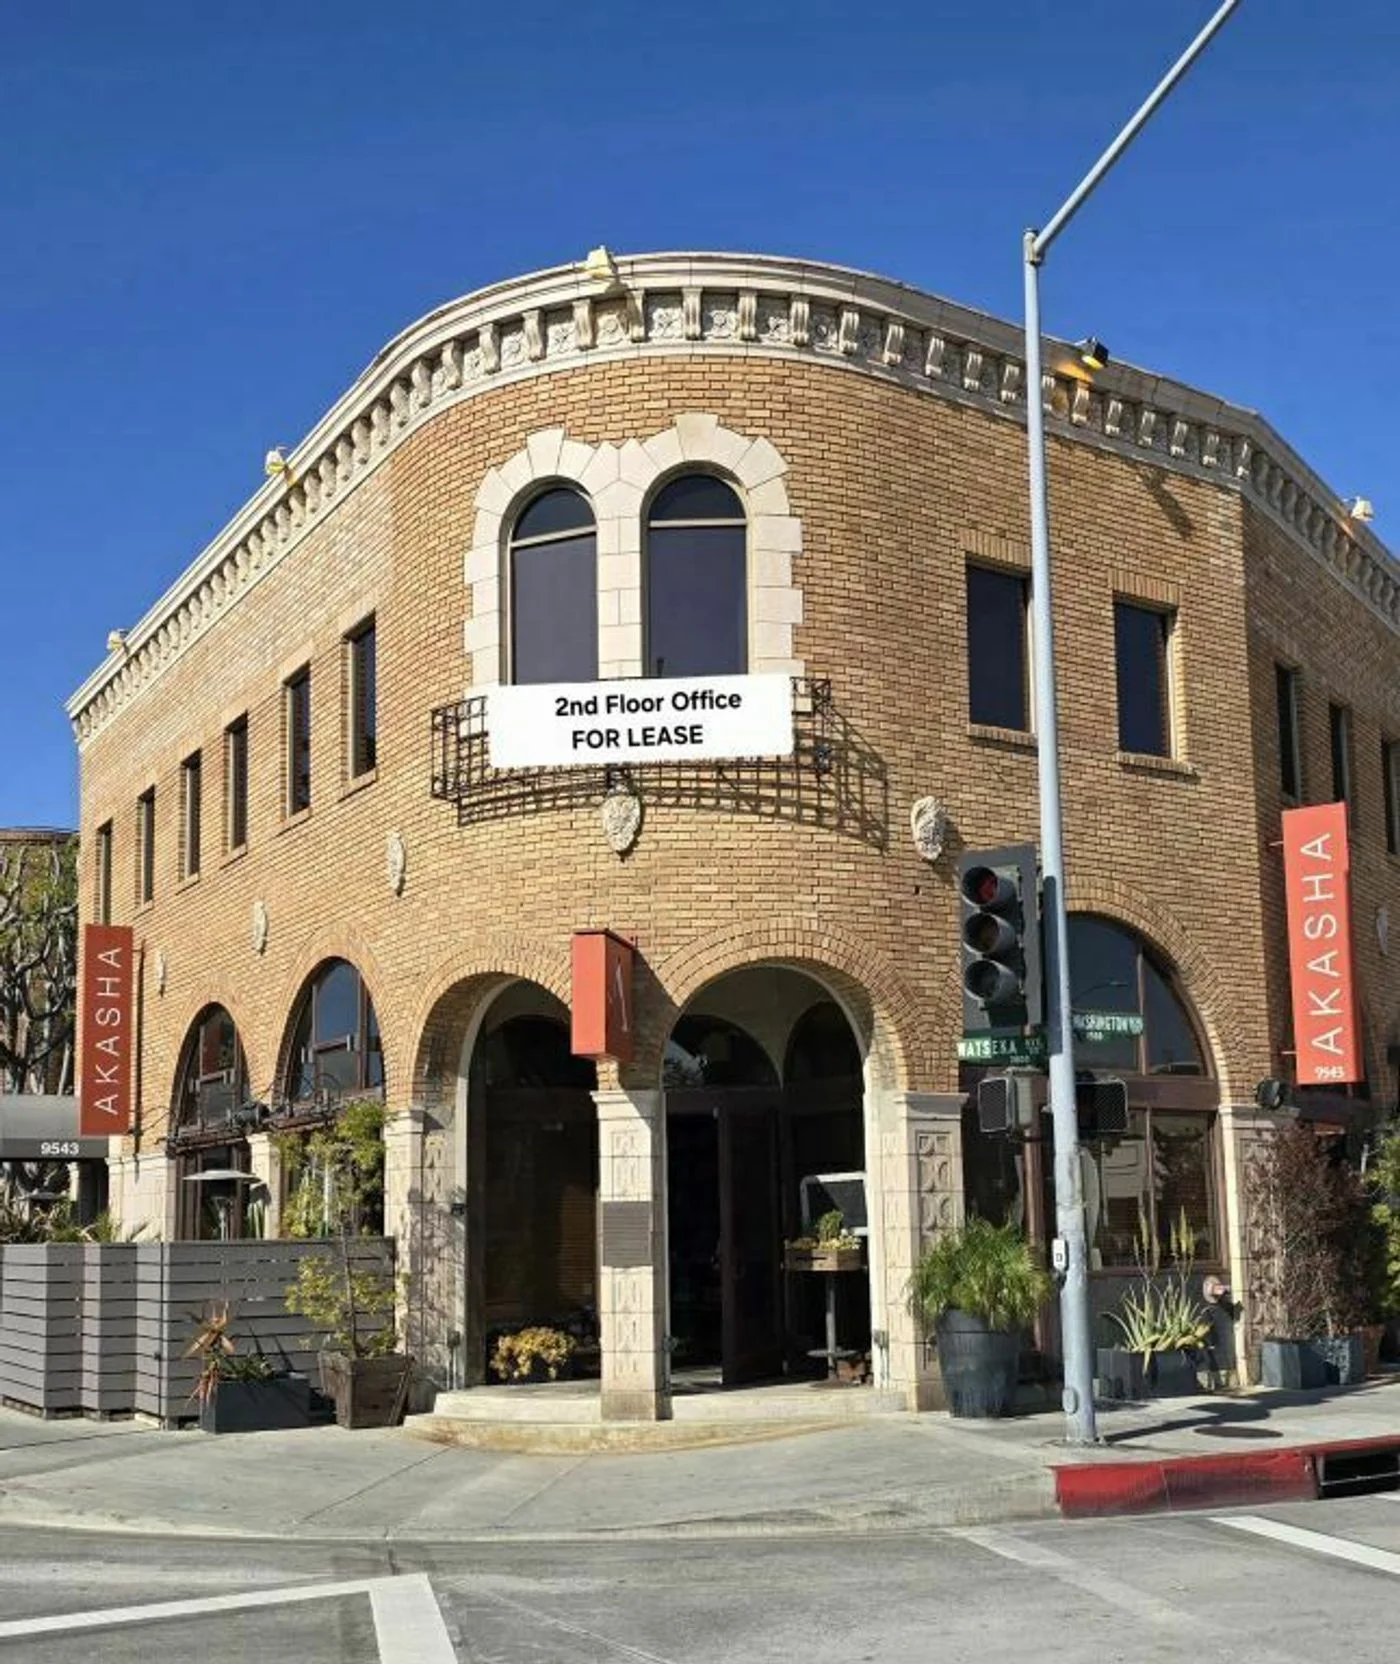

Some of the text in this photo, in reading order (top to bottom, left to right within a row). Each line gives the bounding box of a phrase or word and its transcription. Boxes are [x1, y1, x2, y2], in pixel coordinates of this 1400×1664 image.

[555, 689, 742, 717] 2nd Floor Office
[572, 725, 704, 750] FOR LEASE
[1300, 833, 1344, 1055] AKASHA
[94, 947, 122, 1116] AKASHA
[956, 1040, 1018, 1058] WATSEKA
[40, 1142, 80, 1156] 9543
